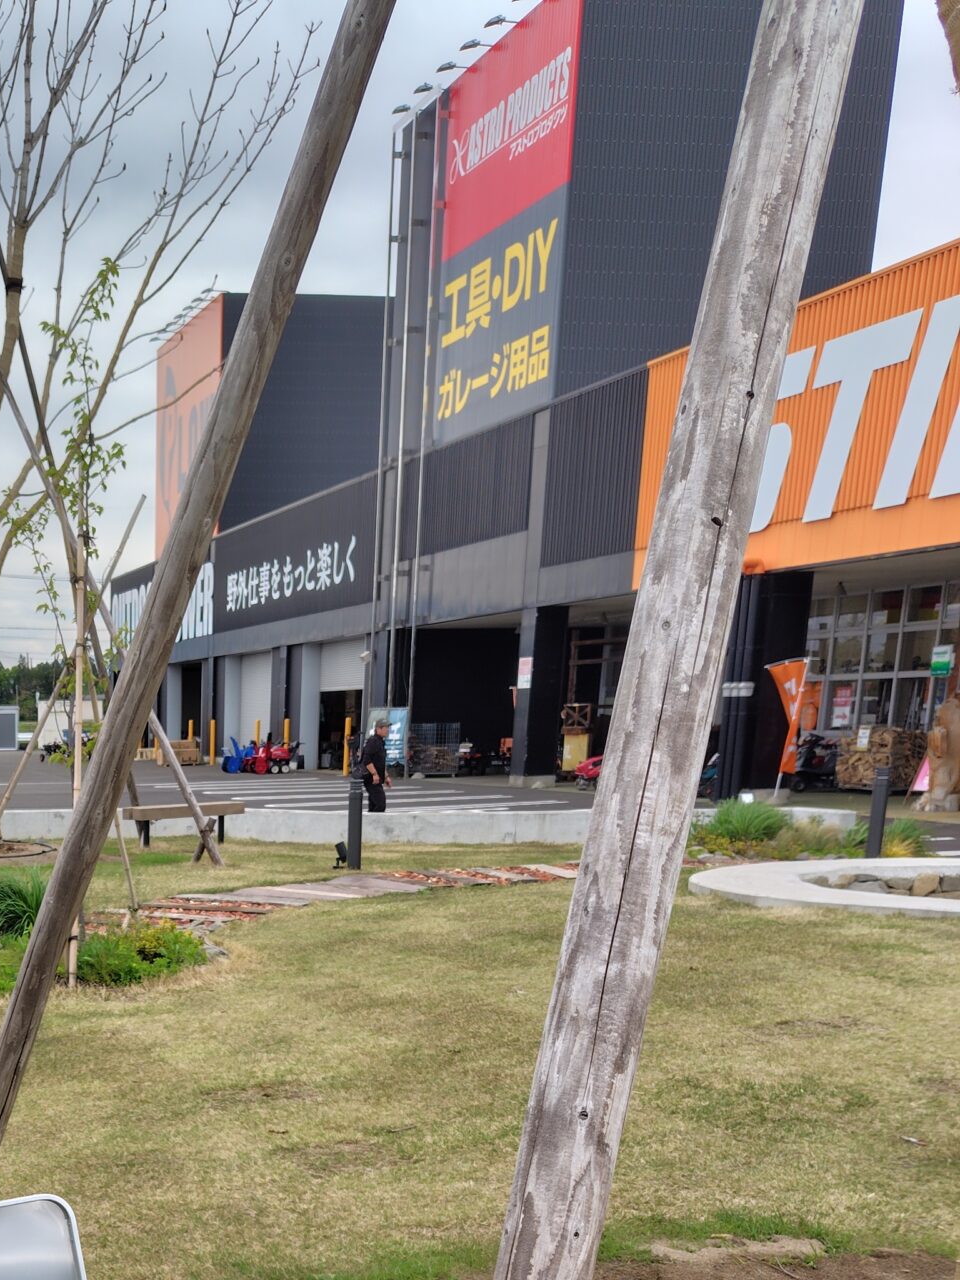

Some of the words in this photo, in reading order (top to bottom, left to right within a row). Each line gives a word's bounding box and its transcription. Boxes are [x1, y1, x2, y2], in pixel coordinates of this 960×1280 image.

[466, 100, 506, 170] ASTRO
[504, 46, 572, 142] PRODUCTS
[508, 104, 569, 161] アストロプロダクツ
[437, 325, 550, 421] ガレージ用品
[748, 294, 960, 533] TI
[225, 534, 357, 613] 野外仕事をもっと楽しく
